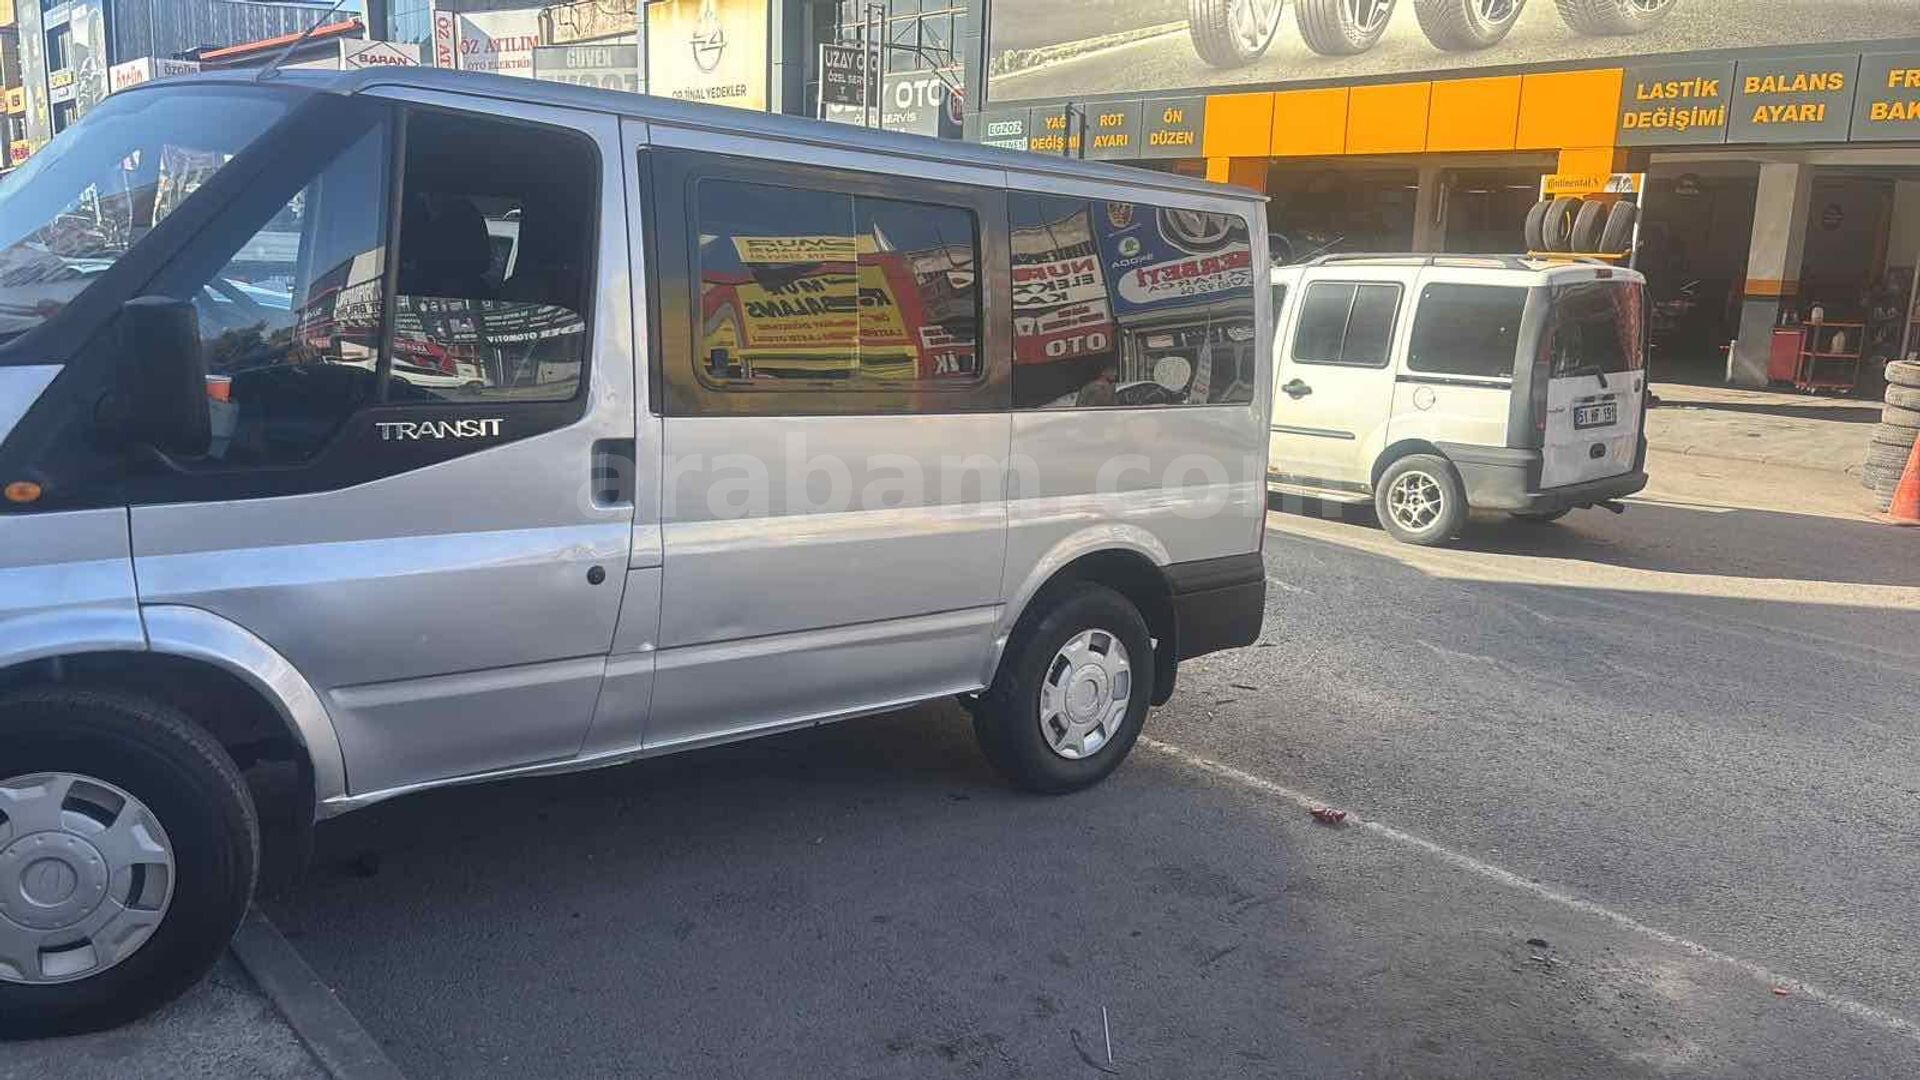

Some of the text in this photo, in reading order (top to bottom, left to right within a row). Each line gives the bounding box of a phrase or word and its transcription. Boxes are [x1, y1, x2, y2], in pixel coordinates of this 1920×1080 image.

[460, 35, 540, 54] ÖZ ATILIM
[359, 53, 408, 65] BARAN
[825, 51, 853, 69] UZAY
[706, 84, 747, 99] YEDEKLER
[1636, 77, 1720, 100] LASTİK
[1744, 72, 1844, 94] BALANS
[1099, 113, 1125, 127] ROT
[1163, 107, 1182, 123] ÖN
[1622, 105, 1725, 131] DEĞİŞİMİ
[1752, 104, 1825, 124] AYARI
[988, 121, 1022, 136] EGZOZ
[1094, 133, 1129, 148] AYARI
[1150, 130, 1194, 146] DÜZEN
[375, 418, 504, 441] TRANSIT
